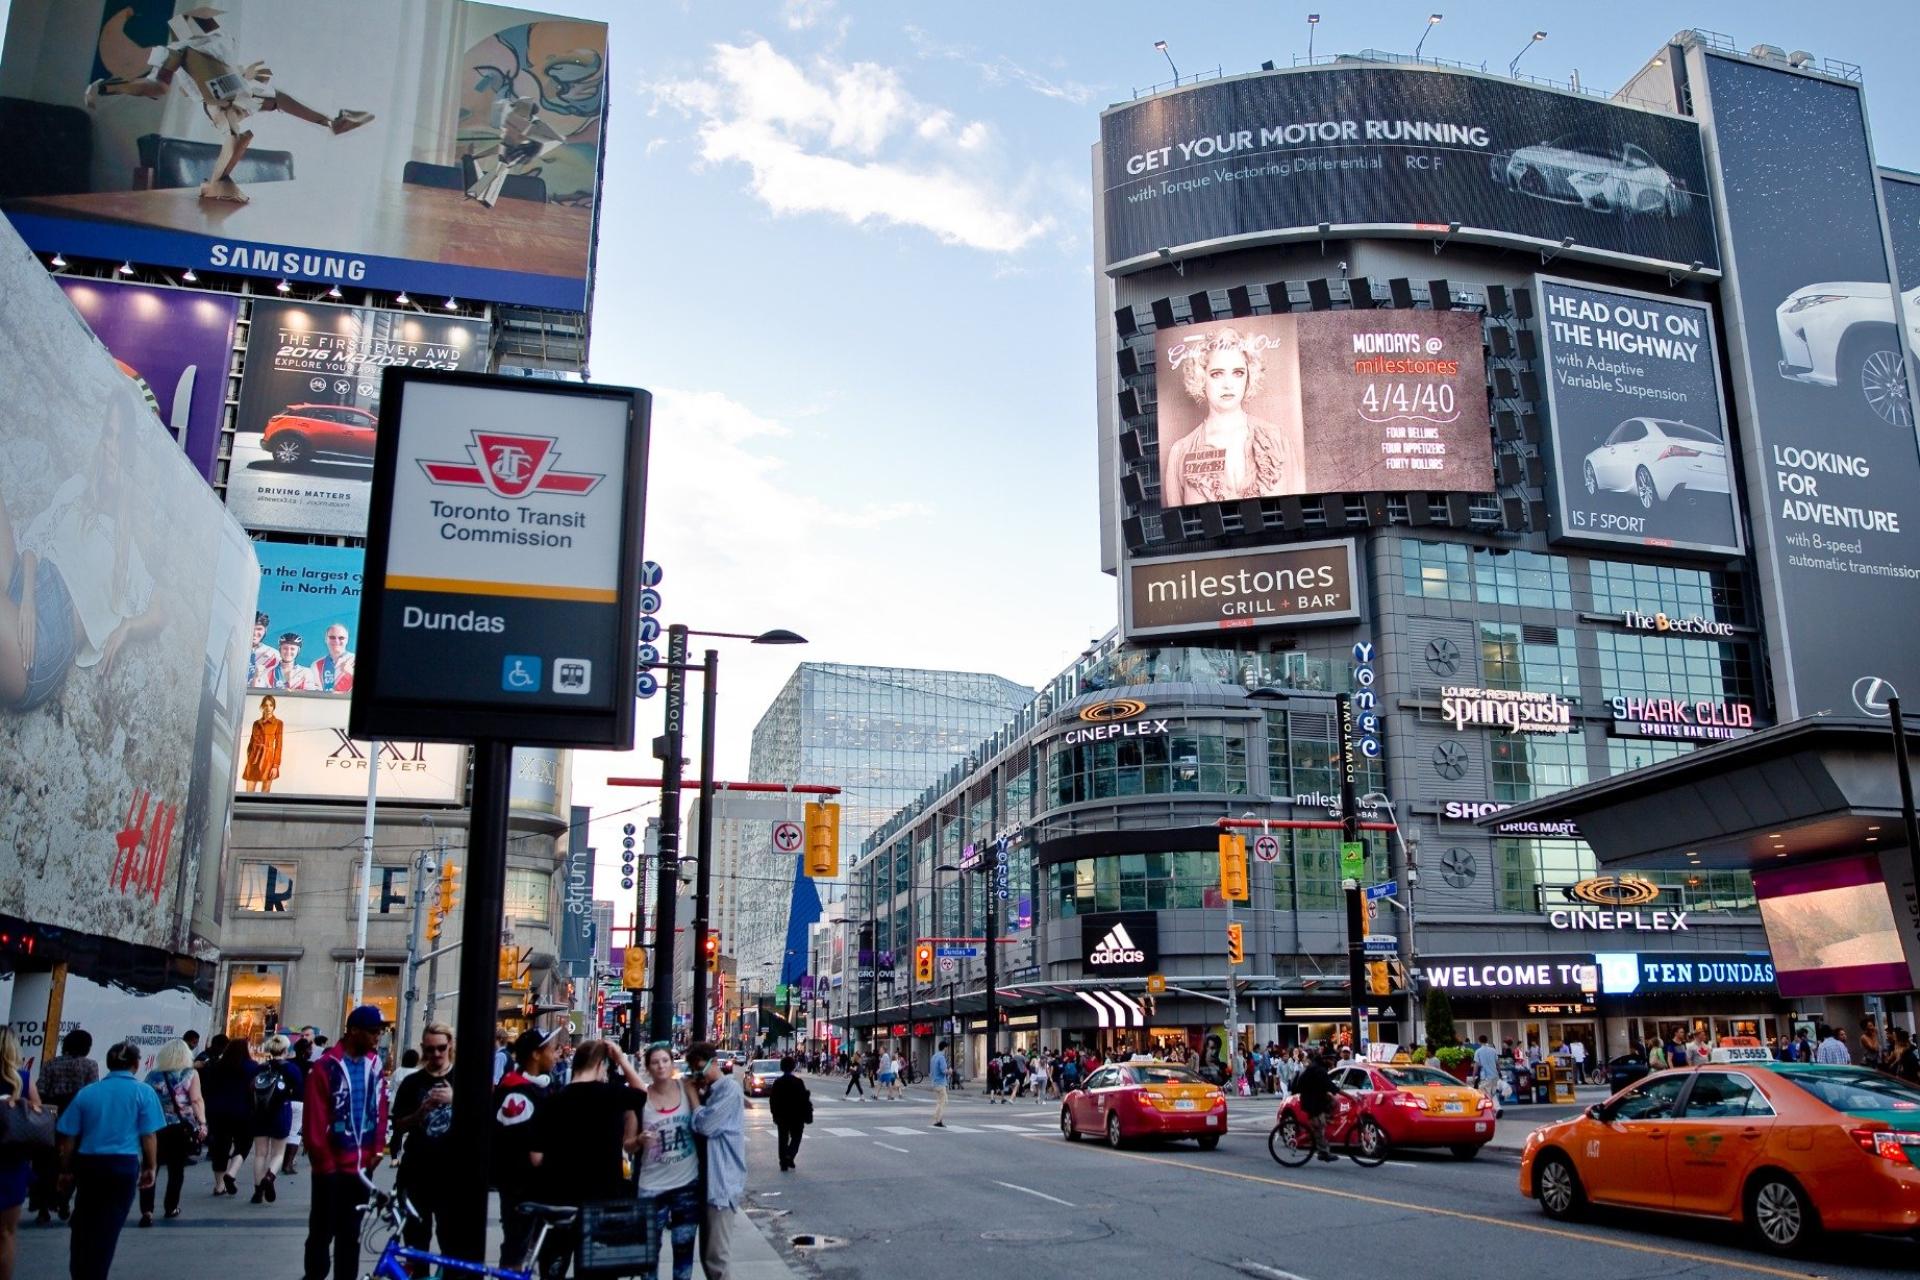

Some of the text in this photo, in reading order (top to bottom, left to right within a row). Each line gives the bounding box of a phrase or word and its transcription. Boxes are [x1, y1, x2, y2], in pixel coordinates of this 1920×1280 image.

[1126, 120, 1490, 175] GET YOUR MOTOR RUNNING
[1405, 155, 1444, 171] RC F
[1127, 154, 1383, 203] with Torque Vectoring Differential
[210, 244, 366, 281] SAMSUNG
[1548, 294, 1700, 339] HEAD OUT ON
[276, 346, 330, 360] 2016
[278, 332, 461, 362] THE FIRST-EVER AWD
[1253, 334, 1281, 351] Out
[1352, 333, 1443, 355] MONDAYS @
[1550, 320, 1699, 363] THE HIGHWAY
[274, 358, 322, 369] EXPLORE
[326, 362, 353, 373] YOUR
[1355, 355, 1458, 375] milestones
[1555, 353, 1645, 378] with Adaptive
[1555, 368, 1688, 403] Variable Suspension
[1362, 383, 1455, 413] 4/4/40
[1386, 458, 1409, 470] FORTY
[1773, 444, 1871, 478] LOOKING
[257, 486, 352, 500] DRIVING MATTERS
[1777, 471, 1819, 497] FOR
[430, 500, 587, 529] Toronto Transit
[1572, 510, 1646, 534] IS F SPORT
[1782, 498, 1900, 534] ADVENTURE
[440, 522, 573, 549] Commission
[1785, 531, 1863, 555] with 8-speed
[259, 564, 272, 576] in
[276, 565, 298, 578] the
[301, 566, 349, 582] largest
[1788, 553, 1848, 572] automatic
[280, 581, 293, 593] in
[298, 582, 337, 595] North
[1148, 564, 1335, 603] milestones
[1221, 599, 1276, 616] GRILL
[403, 606, 505, 634] Dundas
[1354, 640, 1380, 758] Yonge
[1612, 695, 1752, 728] SHARK CLUB
[1065, 719, 1169, 745] CINEPLEX
[1343, 701, 1355, 783] DOWNTOWN
[1640, 722, 1735, 739] SPORTS BAR GRILL
[1500, 821, 1577, 834] DRUG MART
[567, 852, 587, 915] atrium
[1550, 911, 1689, 931] CINEPLEX
[1090, 948, 1145, 965] adidas
[1426, 964, 1551, 988] WELCOME
[1644, 963, 1775, 983] TEN DUNDAS
[1537, 1005, 1561, 1014] Dundas
[16, 1021, 38, 1033] TO
[1727, 1048, 1768, 1060] 751-5555
